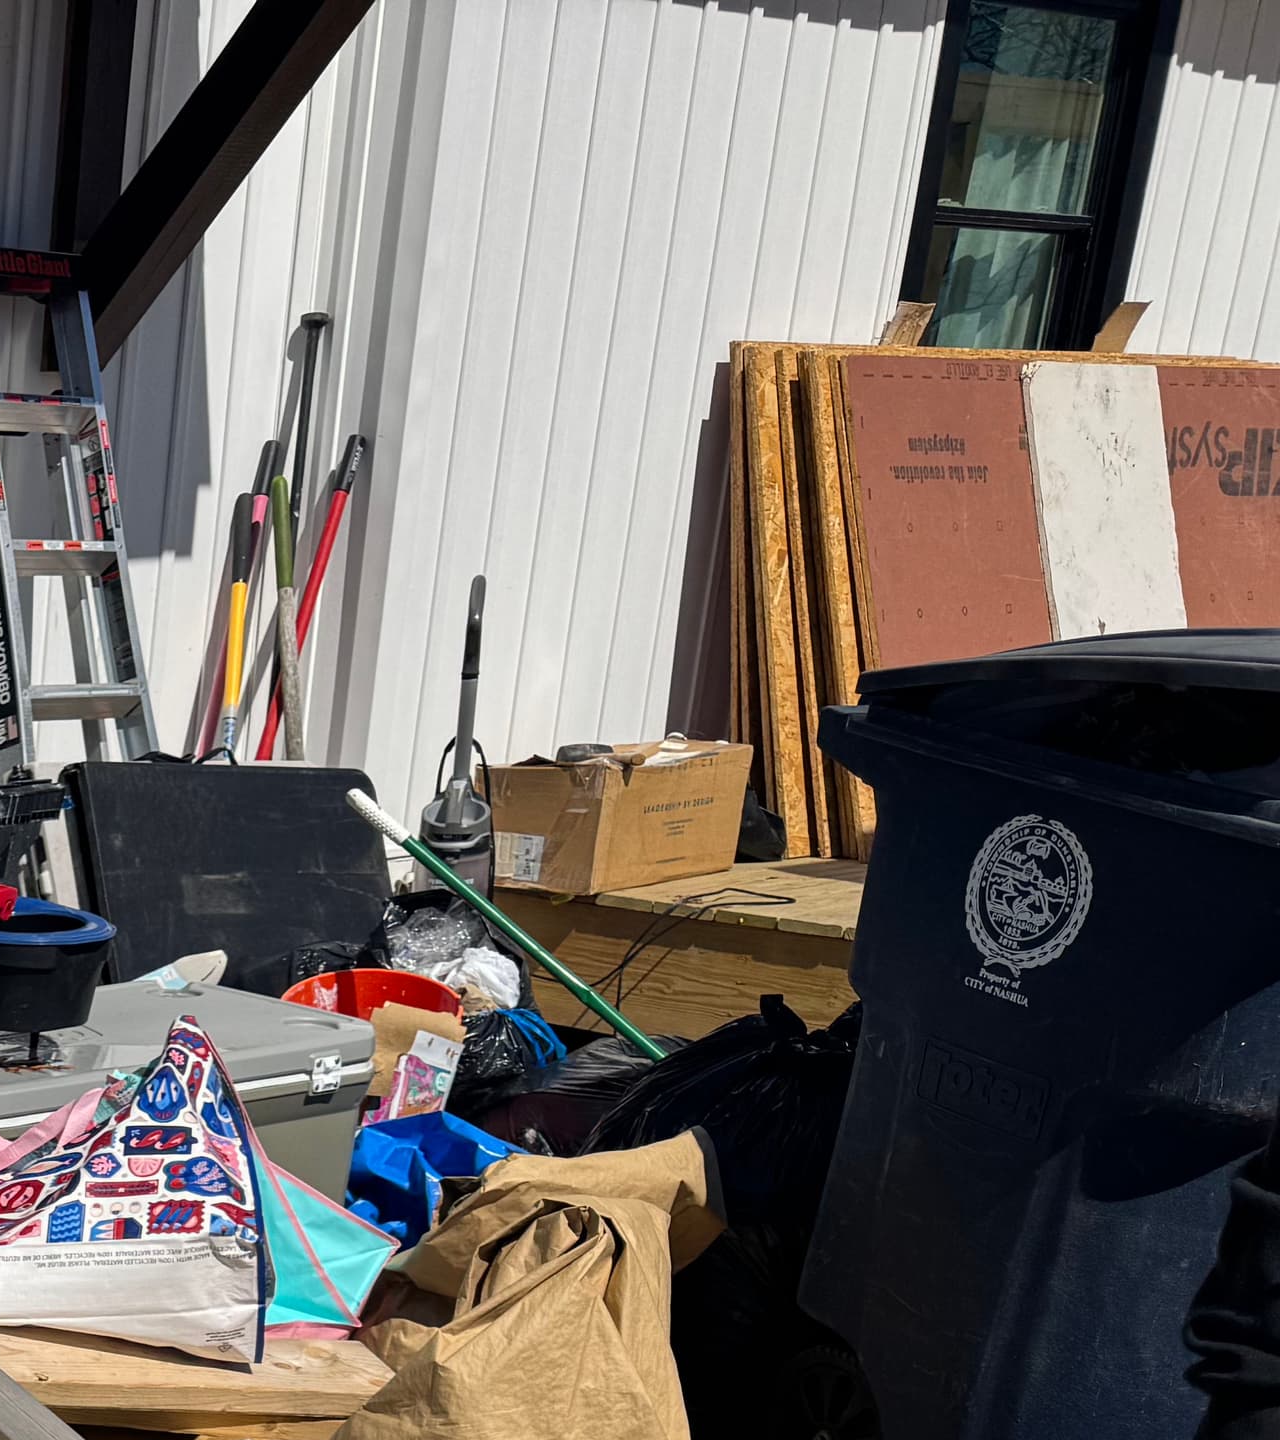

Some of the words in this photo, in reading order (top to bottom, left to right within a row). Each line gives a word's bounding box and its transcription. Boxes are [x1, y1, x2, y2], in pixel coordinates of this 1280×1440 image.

[889, 465, 945, 484] revolution.
[948, 465, 965, 484] the
[967, 465, 989, 484] Join
[1034, 828, 1047, 837] OF
[1050, 833, 1077, 905] DUNSTABLE
[979, 967, 1011, 987] Property
[1011, 980, 1021, 989] of
[964, 977, 985, 991] CITY
[985, 983, 994, 994] of
[993, 987, 1029, 1007] NASHUA
